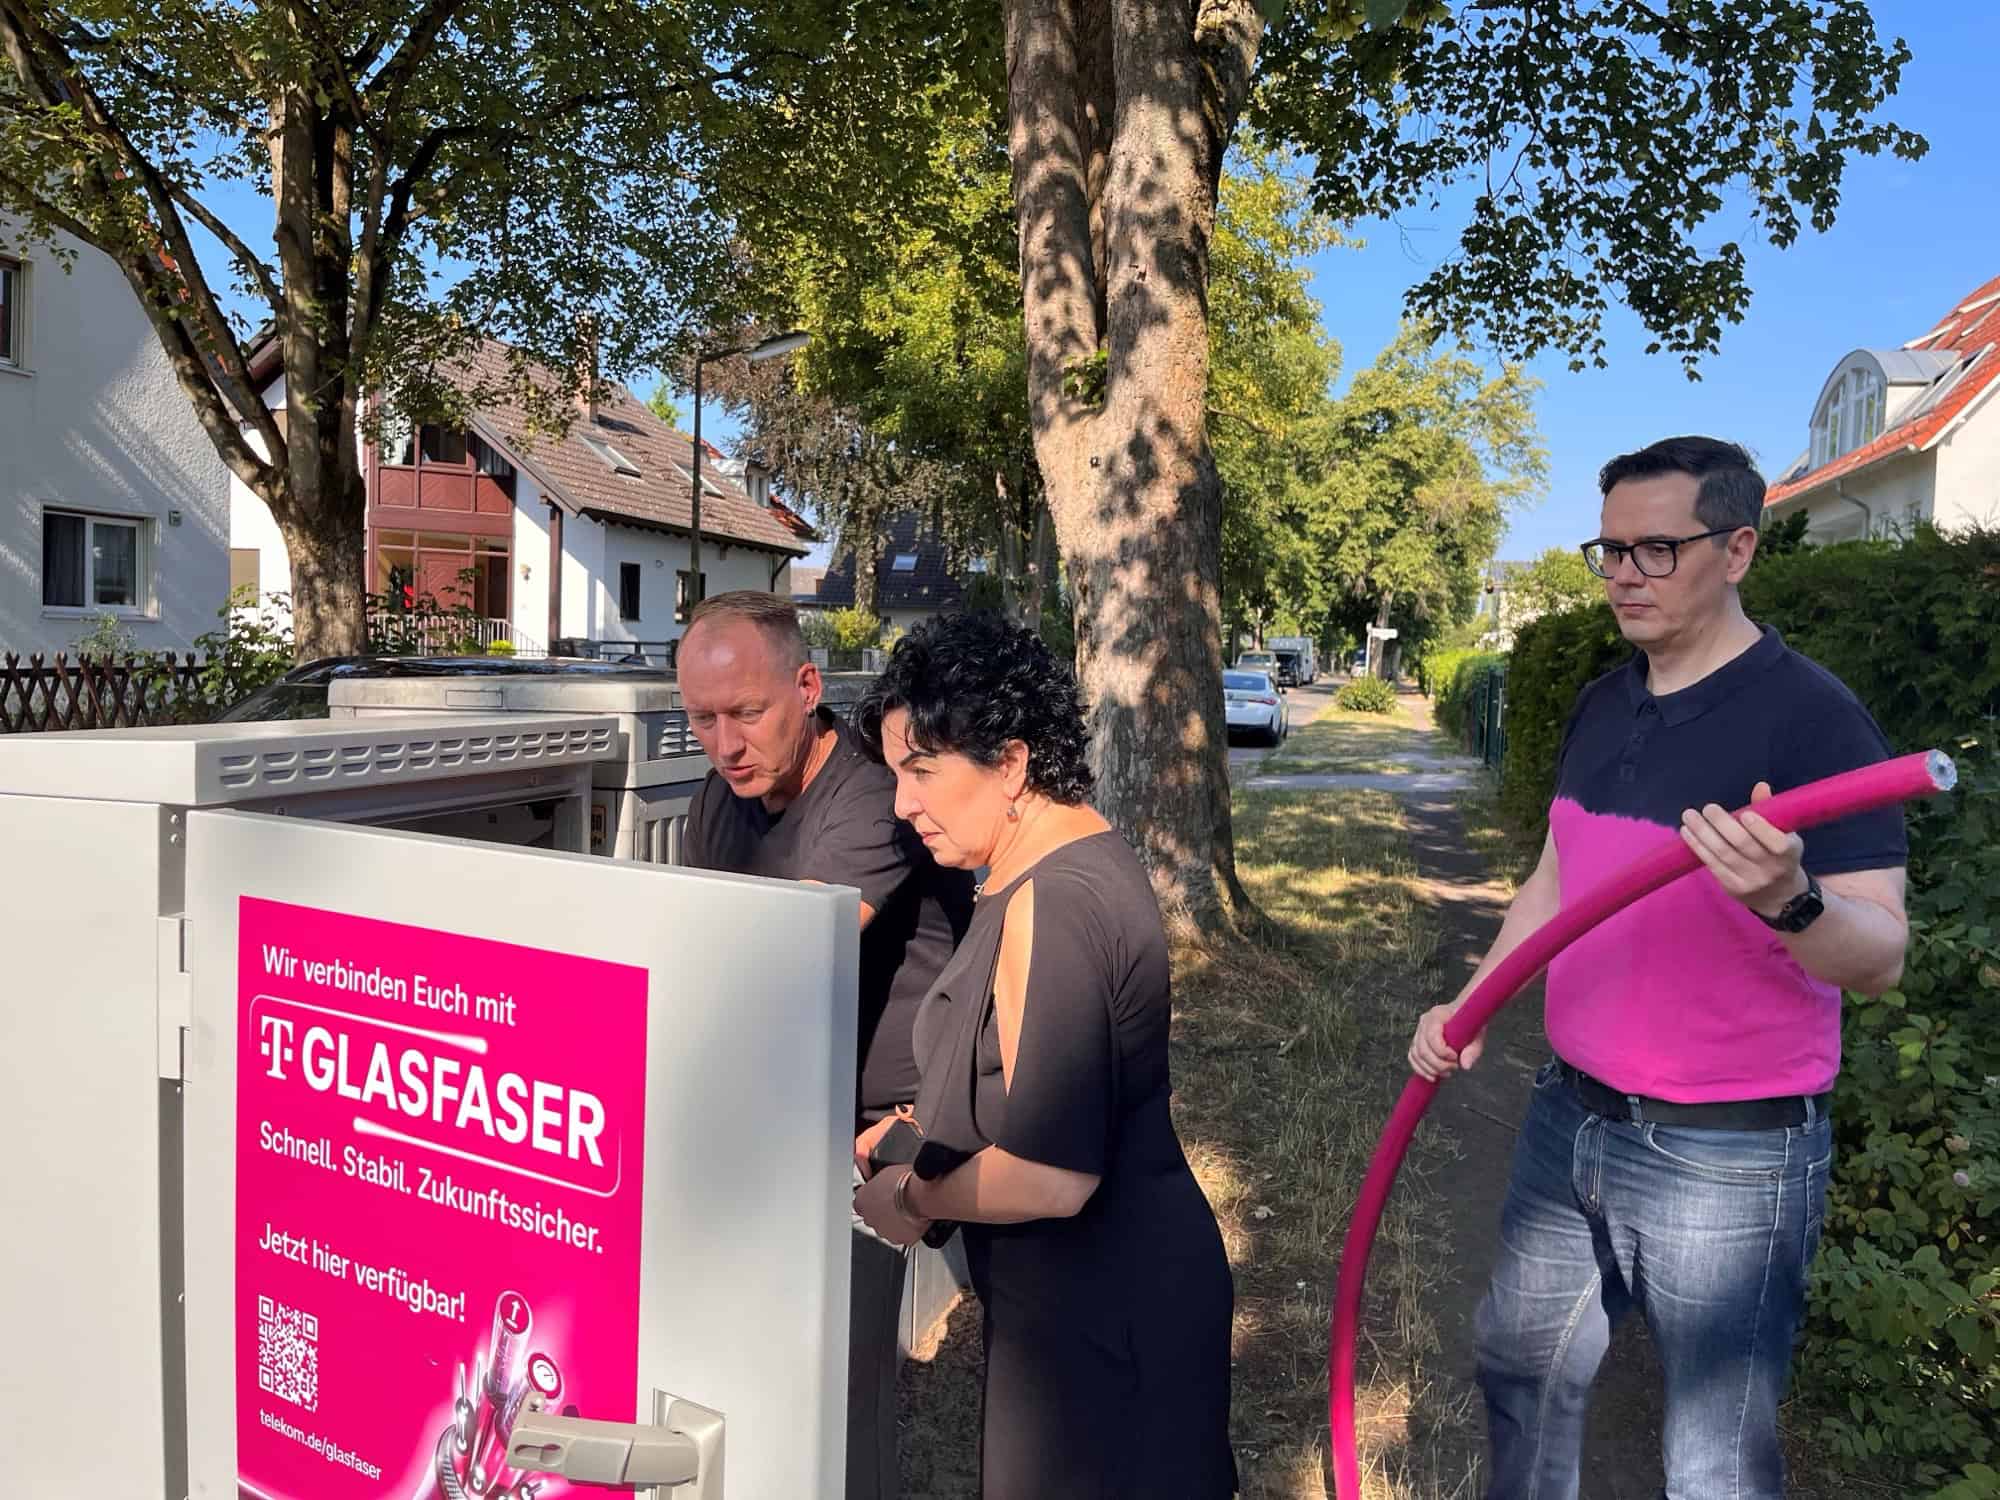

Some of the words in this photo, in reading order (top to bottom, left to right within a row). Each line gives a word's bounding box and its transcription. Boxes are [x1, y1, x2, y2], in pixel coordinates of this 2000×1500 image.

[263, 944, 299, 978] Wir
[302, 958, 407, 1003] verbinden
[413, 975, 469, 1016] Euch
[476, 992, 517, 1027] mit
[302, 1027, 606, 1167] GLASFASER
[260, 1120, 337, 1171] Schnell.
[343, 1146, 412, 1195] Stabil.
[418, 1167, 604, 1254] Zukunftssicher.
[259, 1223, 309, 1265] Jetzt
[312, 1240, 350, 1279] hier
[354, 1262, 465, 1323] verfügbar!
[260, 1408, 382, 1481] telekom.de/glasfaser
